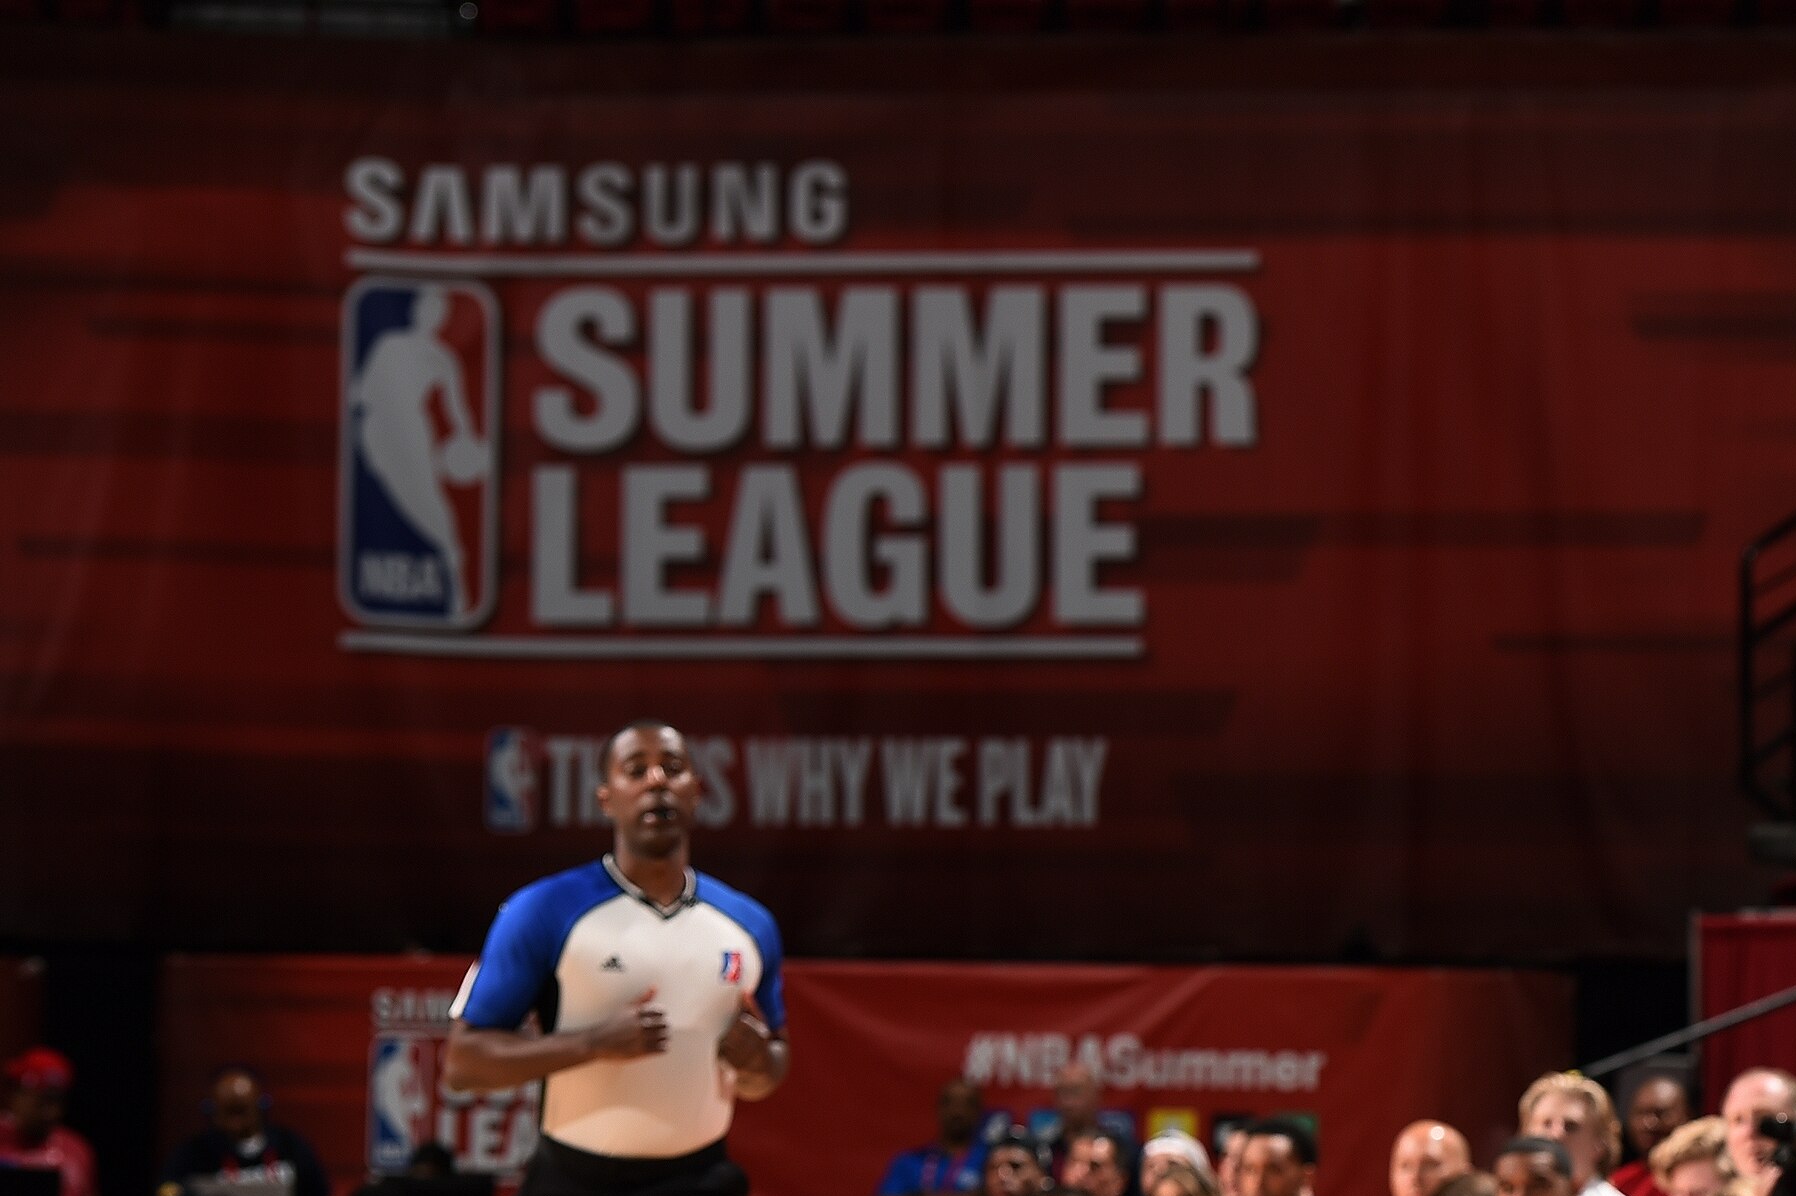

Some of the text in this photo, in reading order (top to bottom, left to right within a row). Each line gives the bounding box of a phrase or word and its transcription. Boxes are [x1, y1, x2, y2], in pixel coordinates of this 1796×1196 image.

[344, 157, 848, 246] SAMSUNG
[533, 284, 1260, 451] SUMMER
[531, 462, 1146, 627] LEAGUE
[745, 736, 872, 829] WHY
[879, 736, 969, 829] WE
[978, 736, 1110, 829] PLAY
